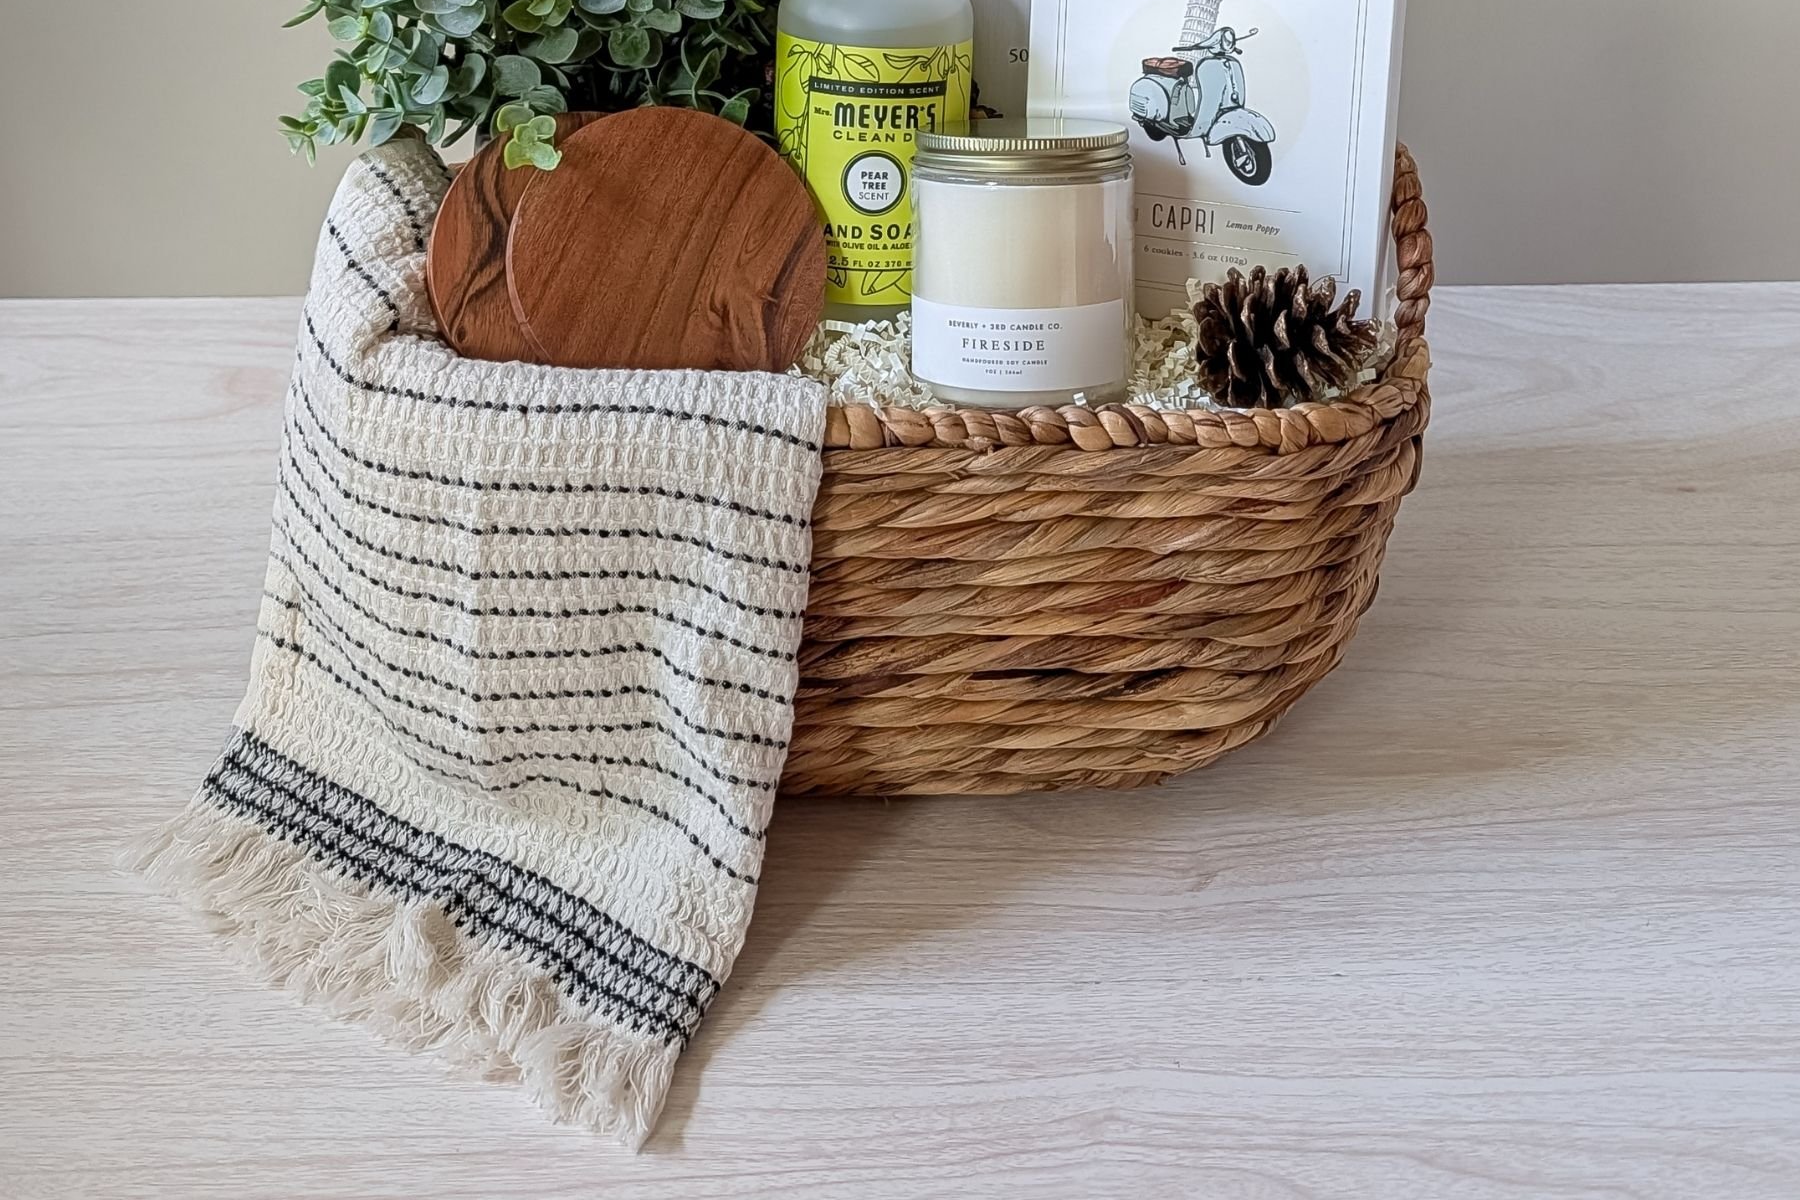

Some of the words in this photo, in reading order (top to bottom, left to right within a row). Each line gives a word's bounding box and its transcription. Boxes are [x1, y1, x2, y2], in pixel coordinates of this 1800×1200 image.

[814, 81, 855, 94] LIMITED
[859, 86, 905, 95] EDITION
[909, 85, 940, 95] SCENT
[813, 106, 832, 117] Mrs.
[833, 130, 896, 143] CLEAN
[860, 171, 889, 180] PEAR
[862, 181, 887, 190] TREE
[858, 191, 889, 201] SCENT
[1151, 202, 1215, 235] CAPRI
[1225, 219, 1254, 232] Lemon
[1255, 224, 1281, 236] Poppy
[823, 222, 863, 240] AND
[842, 241, 866, 250] OLIVE
[867, 243, 881, 251] OIL
[828, 255, 849, 267] 2.5
[852, 260, 864, 268] FL
[867, 260, 881, 268] OZ
[1143, 244, 1150, 253] 6
[1151, 246, 1184, 258] cookies
[1192, 251, 1205, 261] 3.6
[1220, 254, 1248, 267] (102g)
[948, 319, 979, 330] BEVERLY
[990, 323, 1007, 331] 3RD
[1010, 323, 1044, 331] CANDLE
[1047, 322, 1063, 331] CO.
[961, 337, 1045, 352] FIRESIDE
